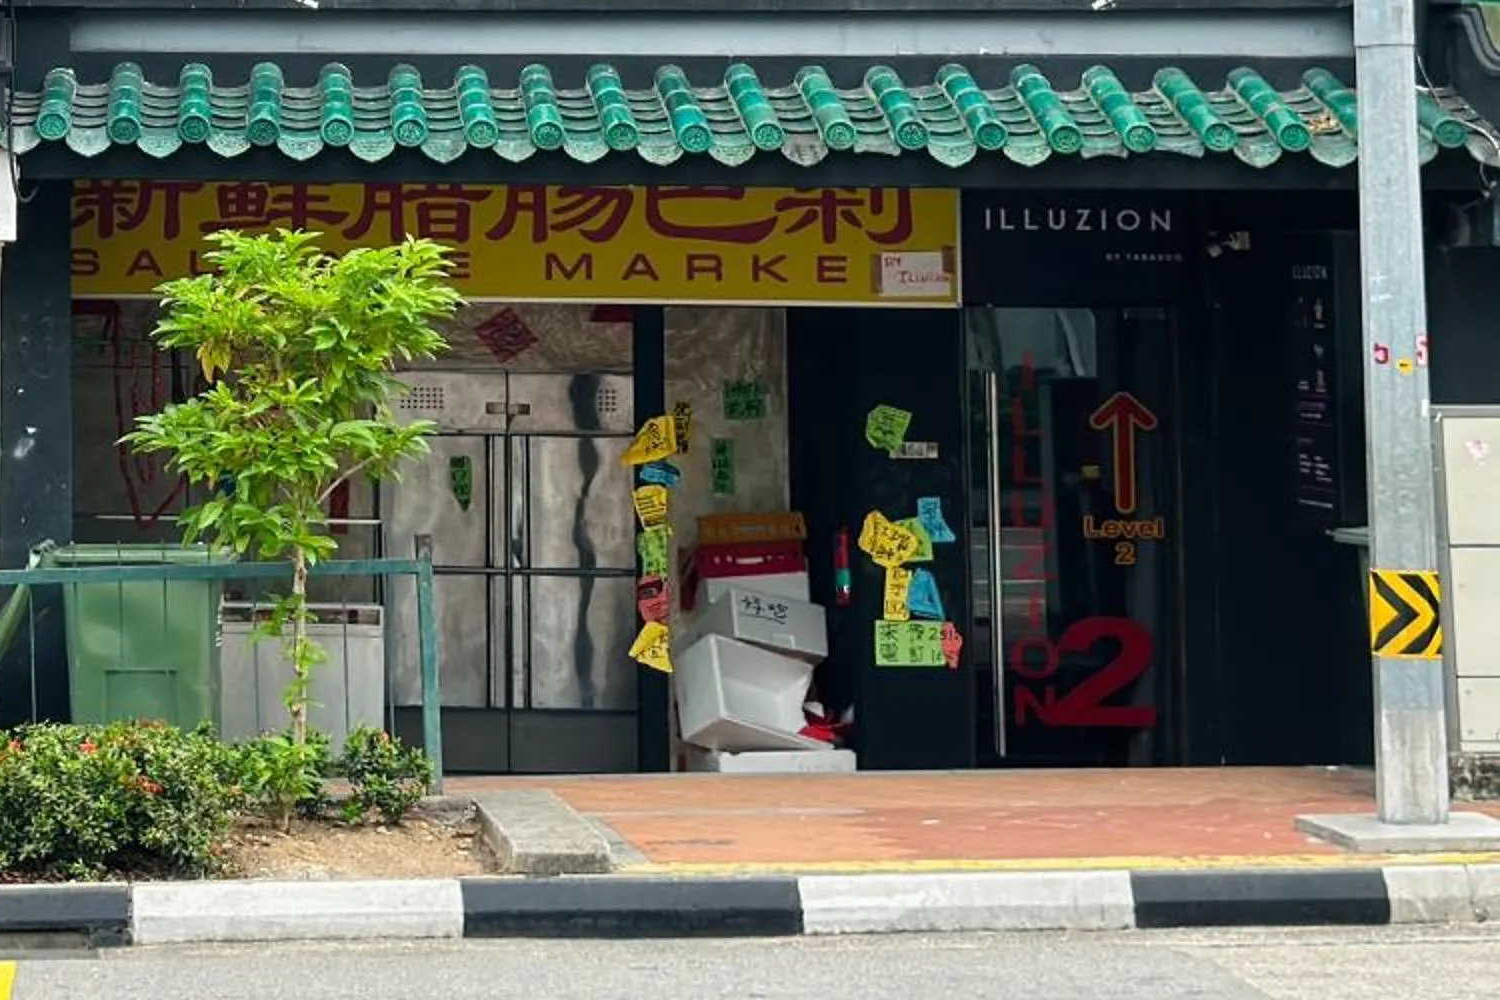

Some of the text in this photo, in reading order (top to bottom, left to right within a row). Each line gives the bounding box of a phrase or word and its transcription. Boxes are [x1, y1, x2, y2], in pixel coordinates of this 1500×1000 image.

[984, 207, 1173, 232] ILLUZION
[1083, 514, 1165, 539] Level
[1114, 541, 1137, 567] 2
[1046, 614, 1157, 728] 2
